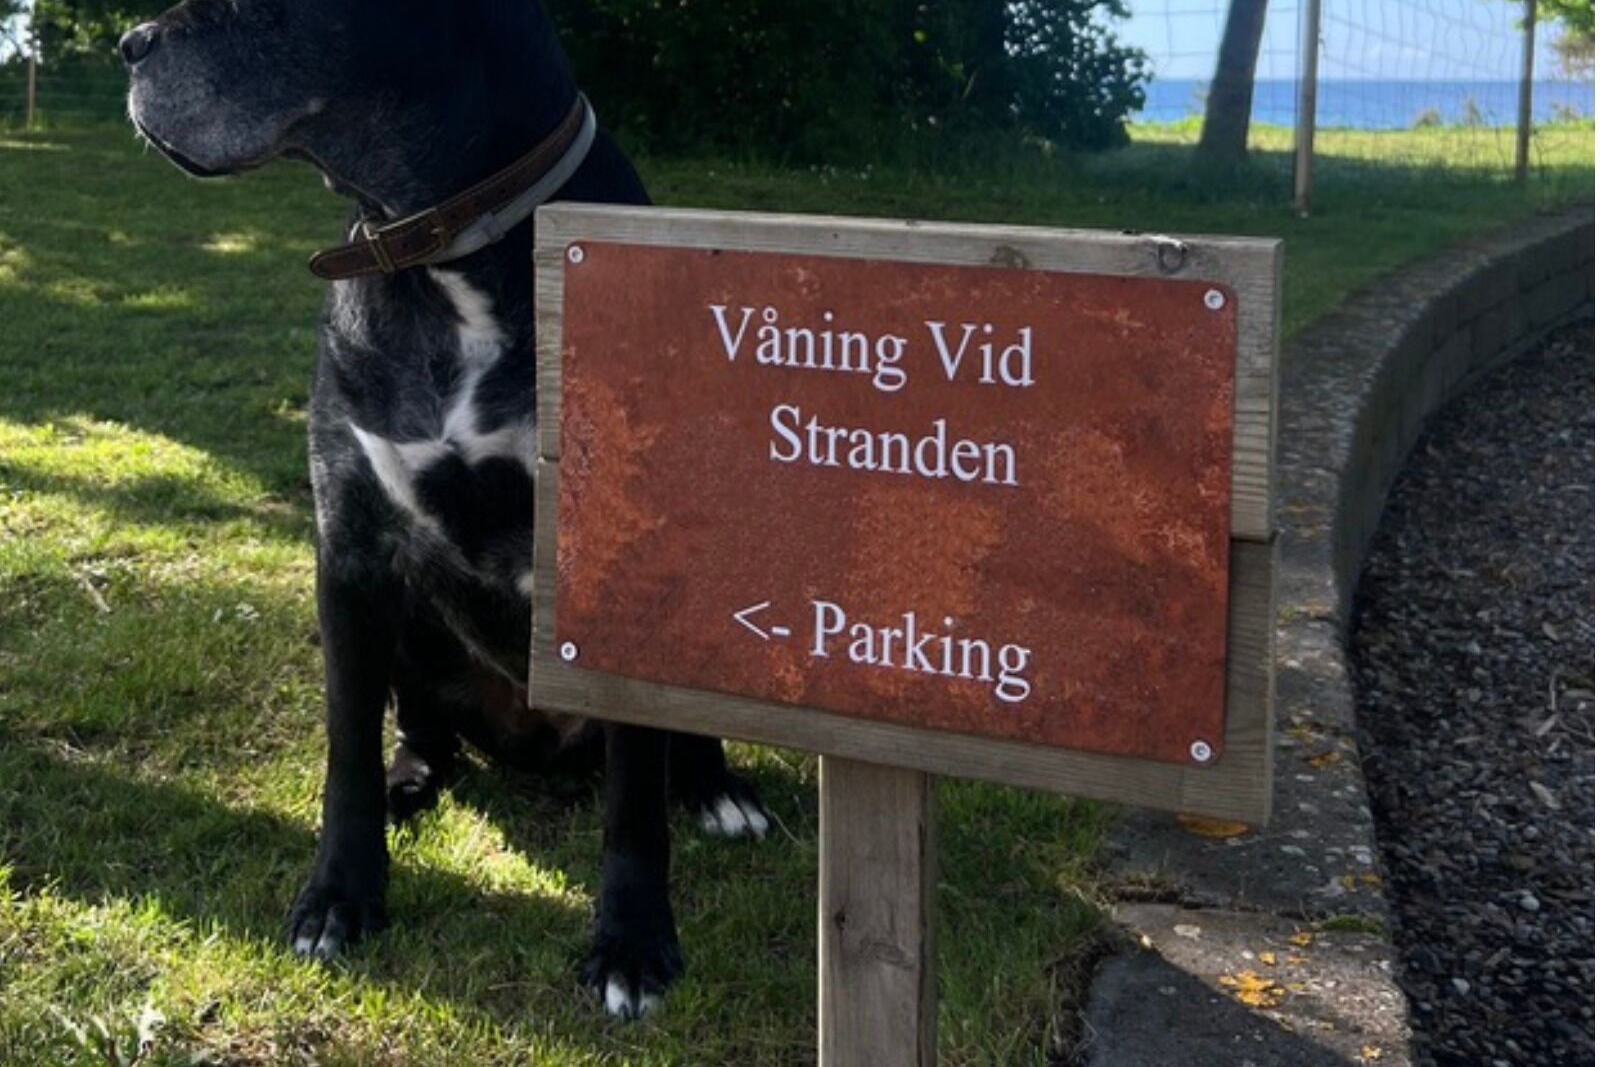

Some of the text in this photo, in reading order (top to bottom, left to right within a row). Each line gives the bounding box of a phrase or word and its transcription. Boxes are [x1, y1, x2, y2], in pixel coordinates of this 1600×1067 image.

[710, 305, 1035, 392] Våning Vid
[770, 405, 1018, 486] Stranden
[811, 601, 1032, 702] Parking
